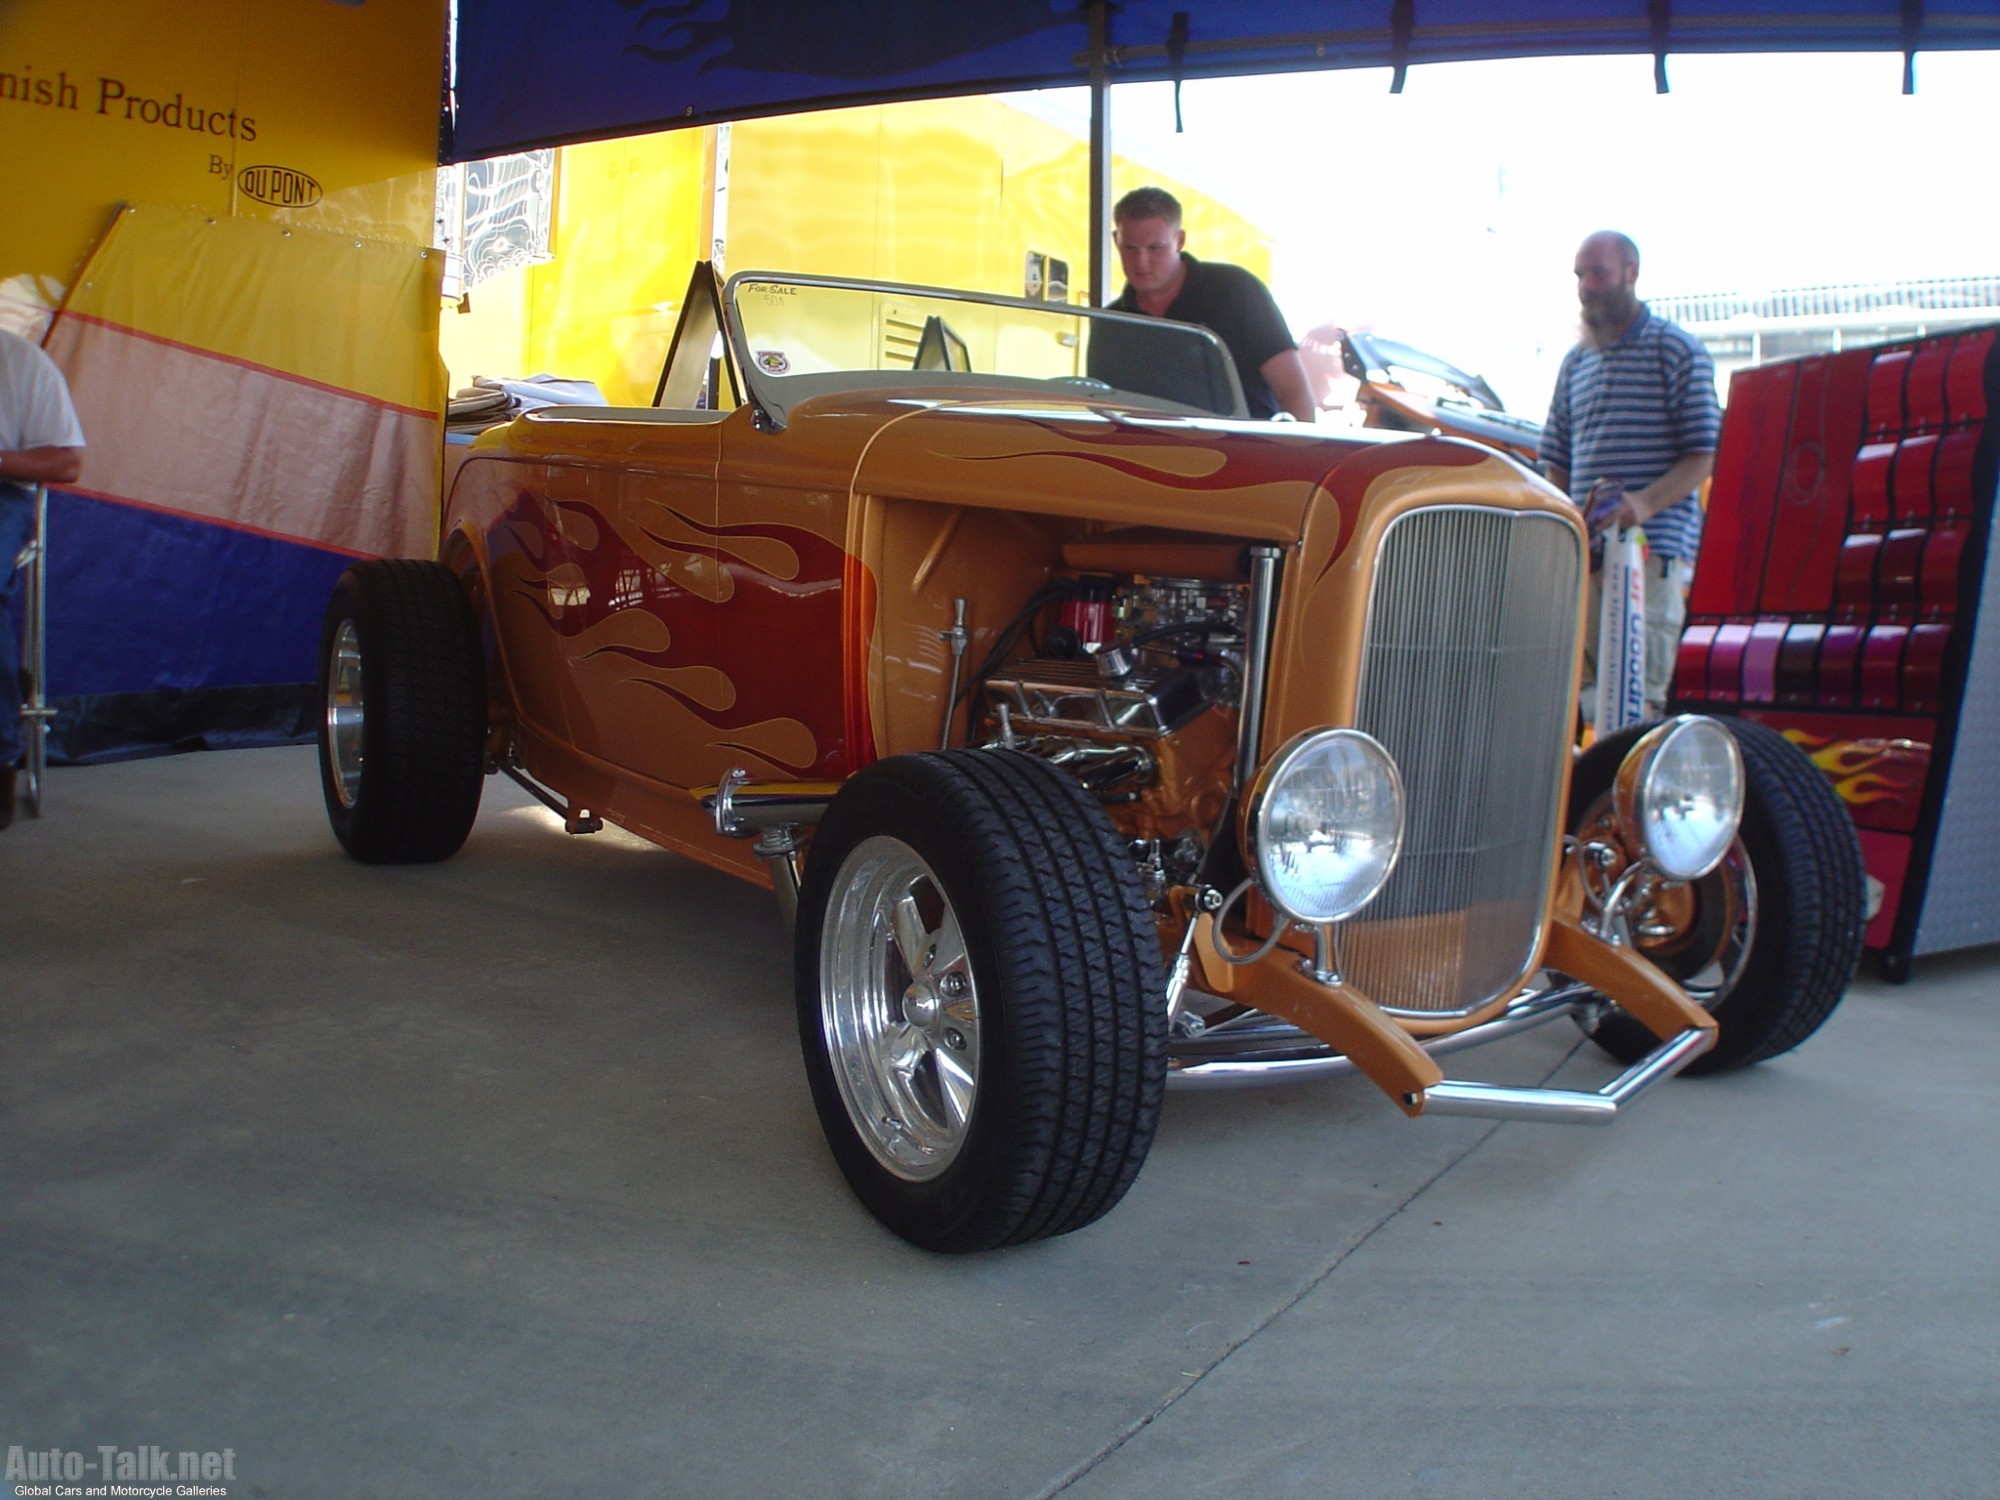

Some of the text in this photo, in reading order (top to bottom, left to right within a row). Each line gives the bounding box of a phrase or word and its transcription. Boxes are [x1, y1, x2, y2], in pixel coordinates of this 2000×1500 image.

[97, 77, 257, 142] Products
[209, 153, 234, 181] By
[270, 169, 316, 204] PONT
[769, 285, 797, 295] SALE
